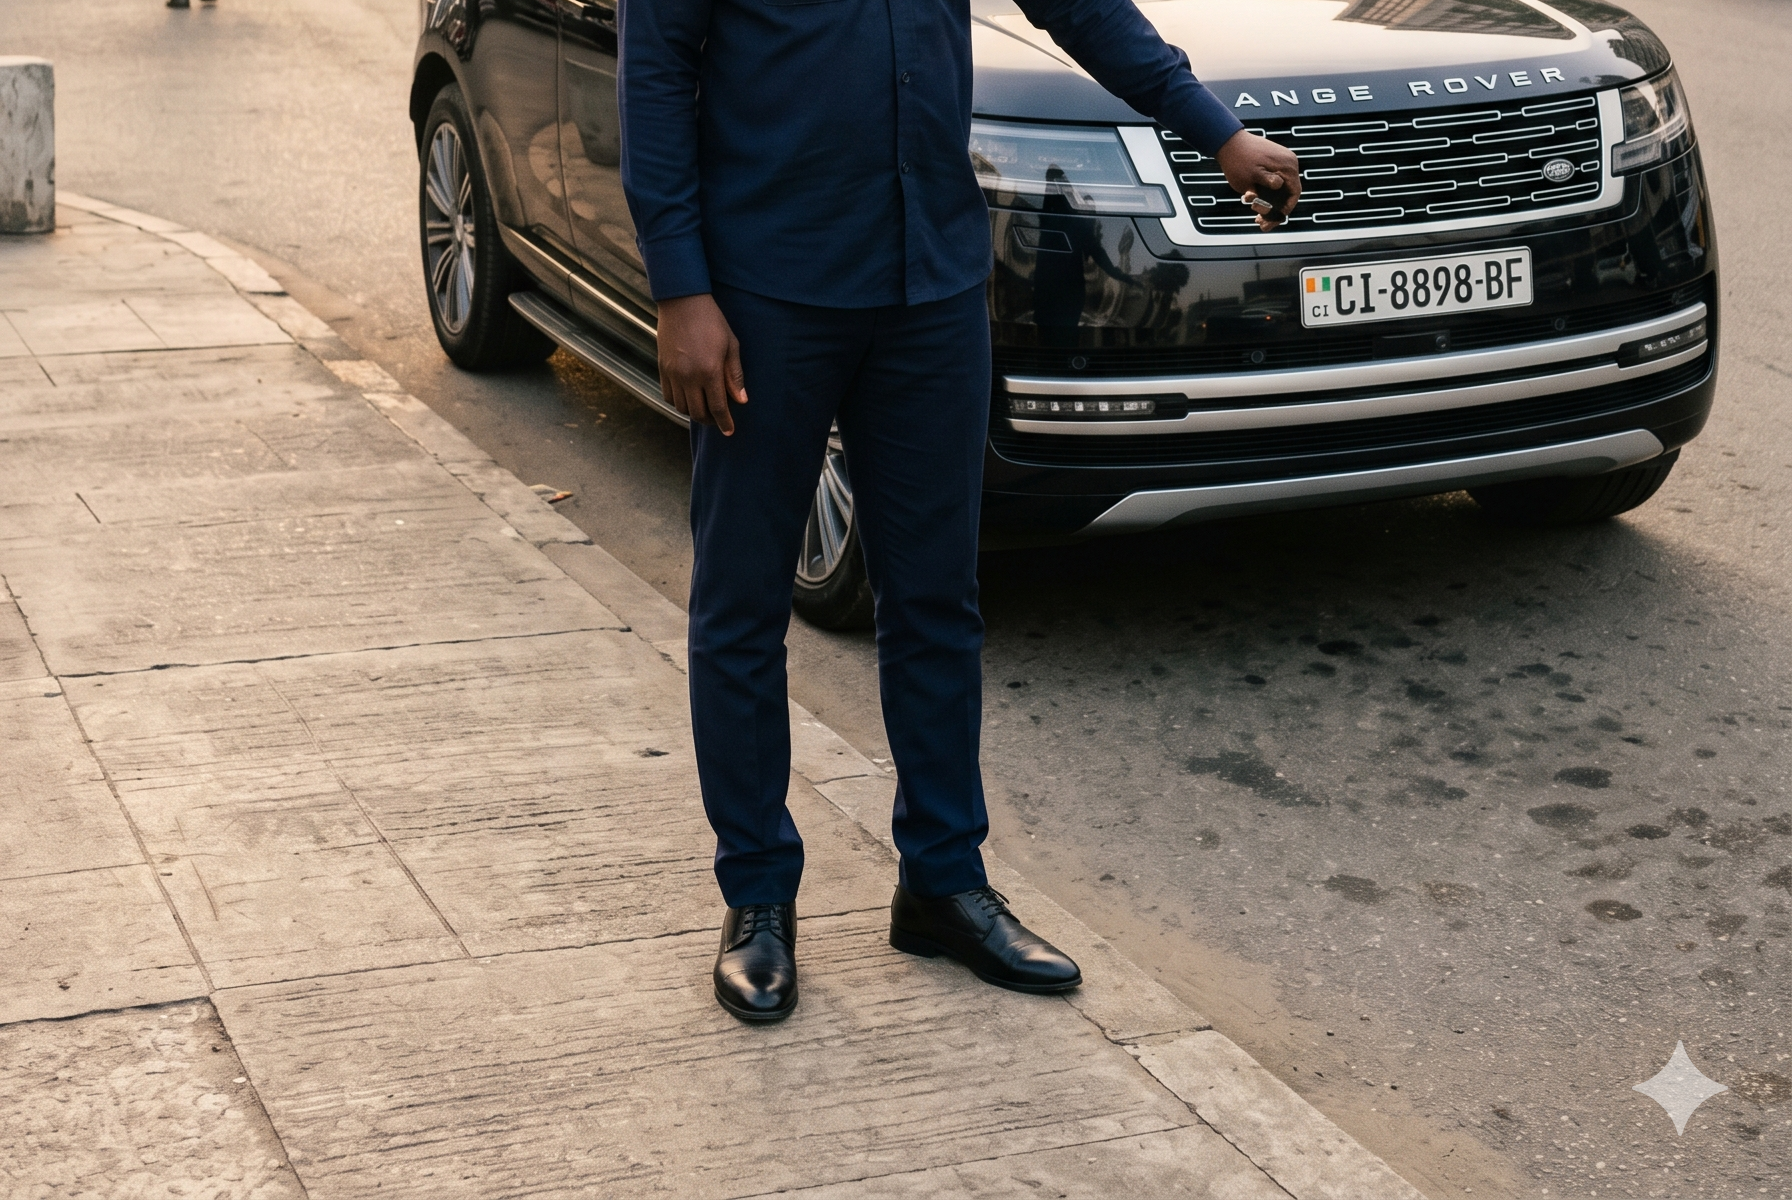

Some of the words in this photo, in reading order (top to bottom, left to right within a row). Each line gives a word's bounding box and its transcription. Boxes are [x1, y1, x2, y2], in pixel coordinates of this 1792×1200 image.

[1234, 85, 1374, 108] ANGE
[1408, 67, 1566, 97] ROVER
[1335, 257, 1523, 316] CI-8898-BF
[1312, 304, 1329, 318] CI
